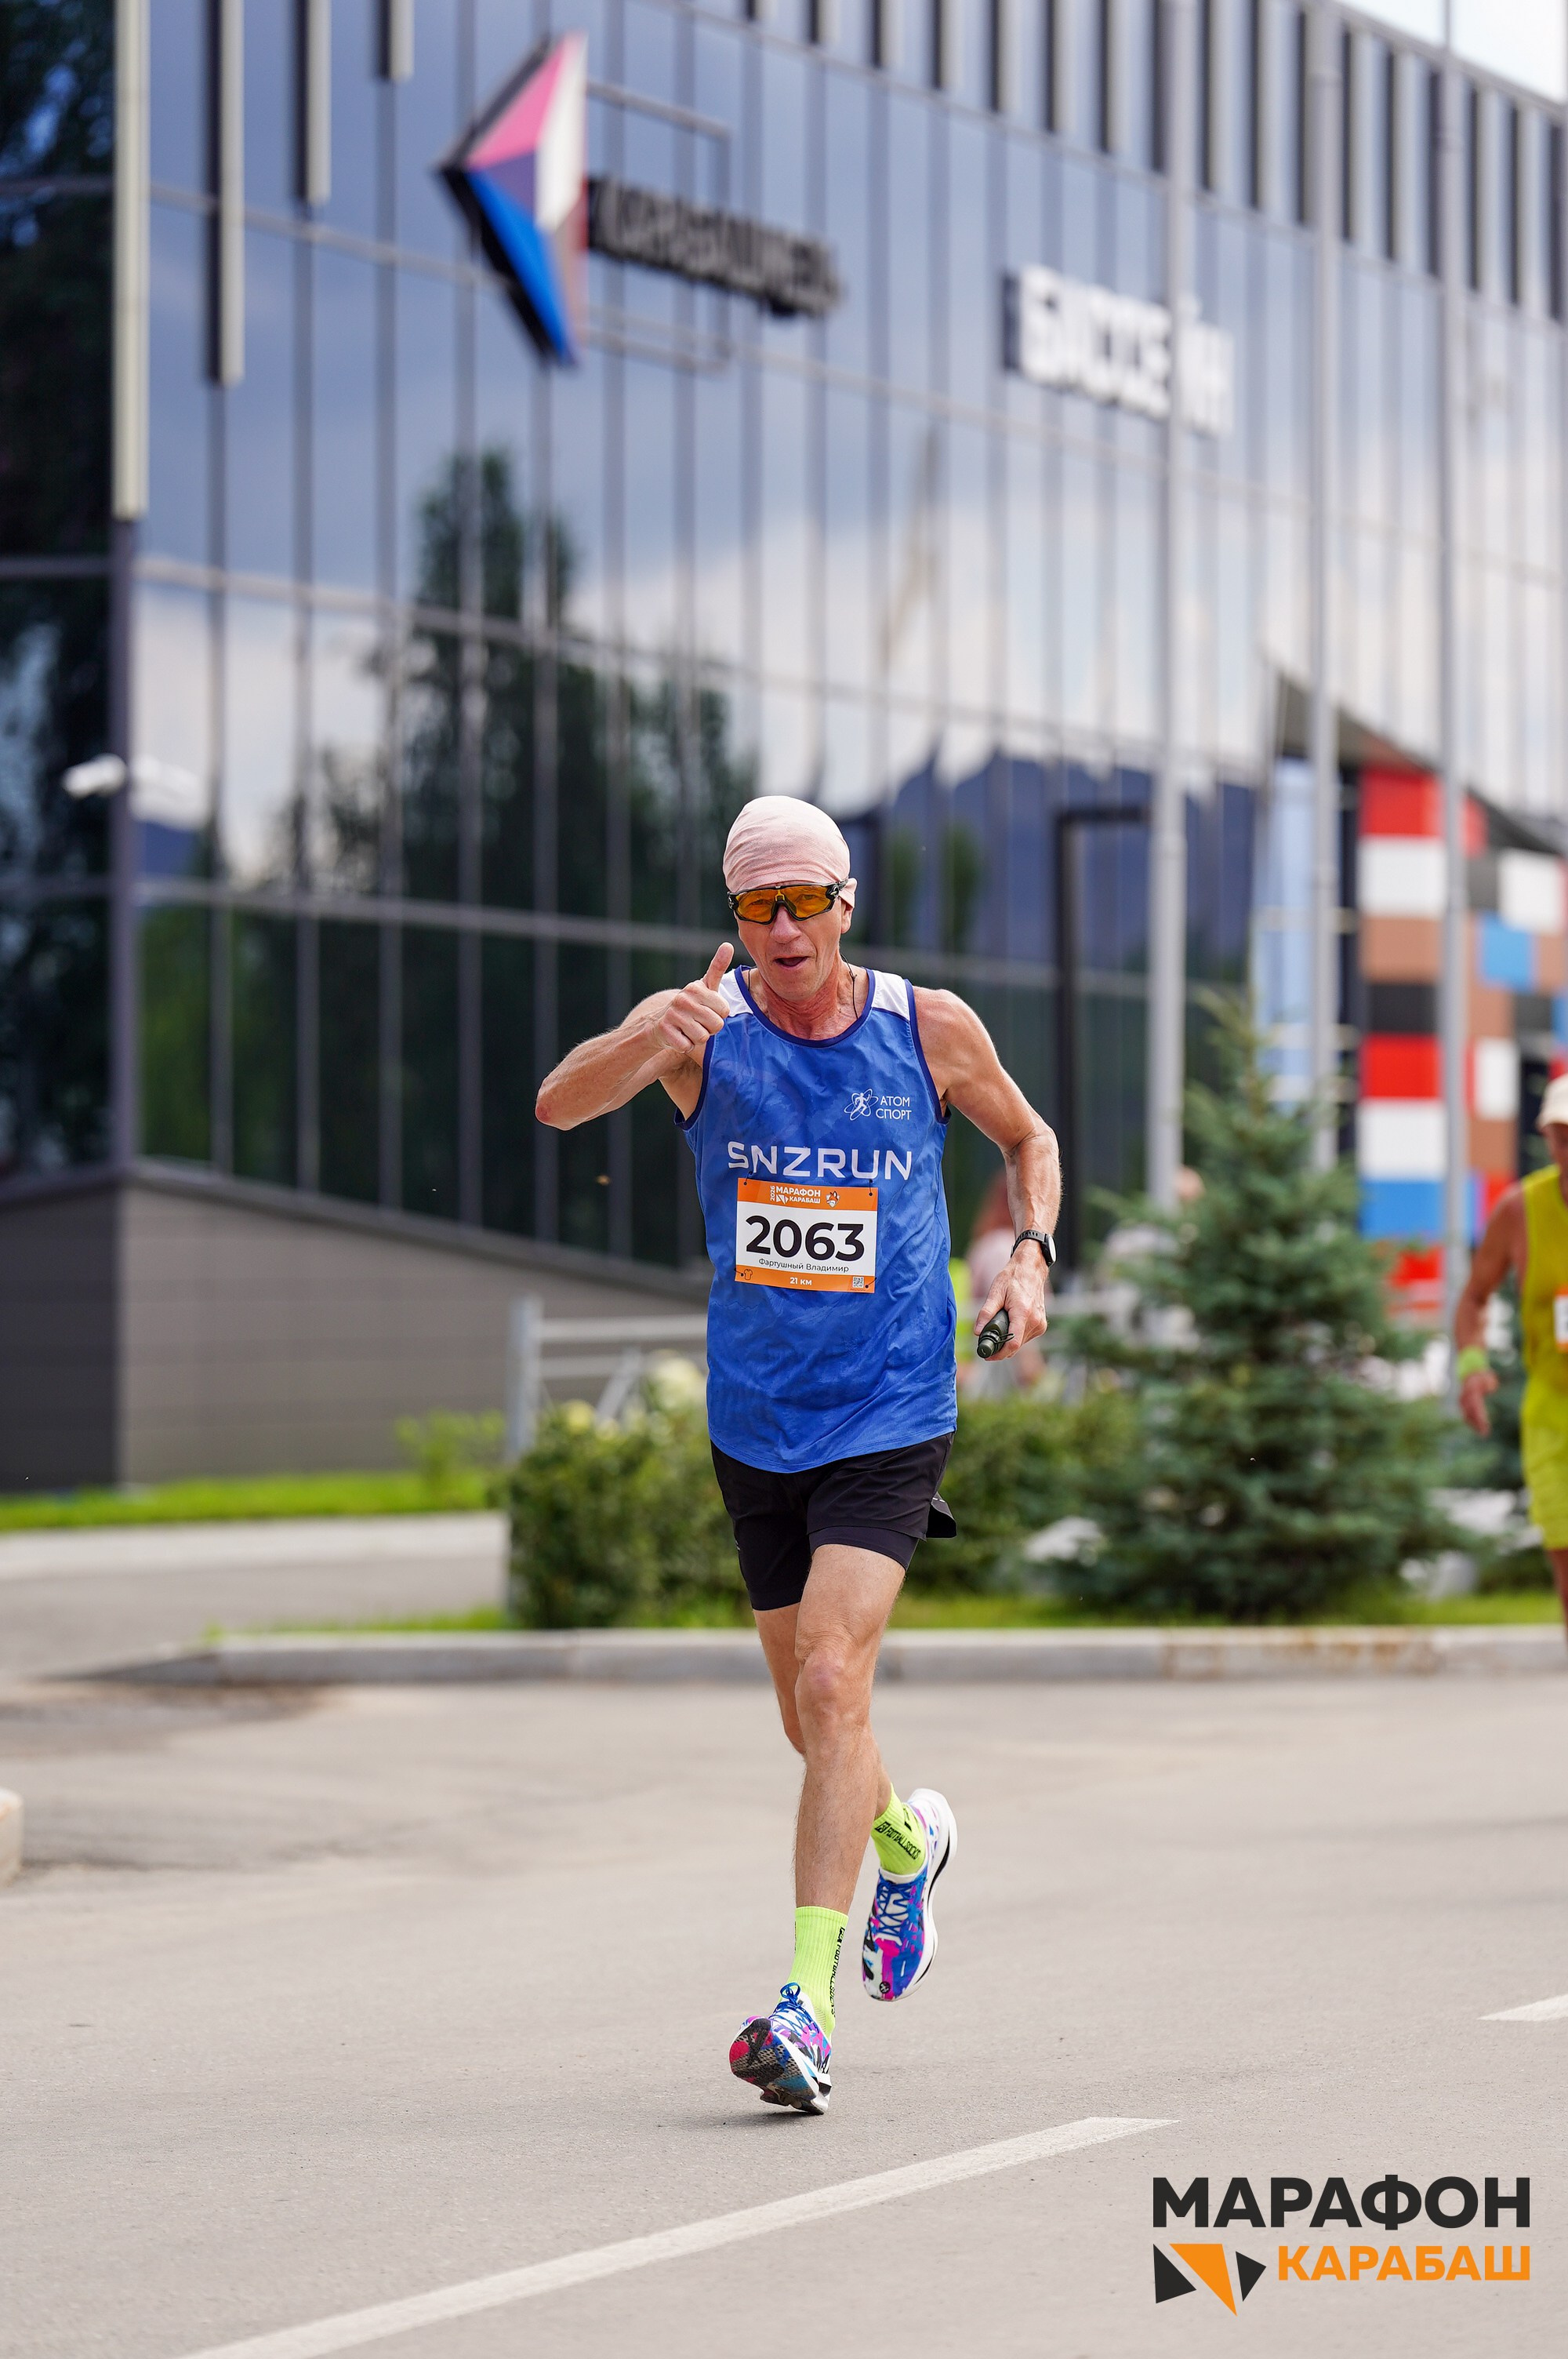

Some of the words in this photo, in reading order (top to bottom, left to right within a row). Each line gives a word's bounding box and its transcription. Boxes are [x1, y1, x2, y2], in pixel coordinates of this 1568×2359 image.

[880, 1096, 910, 1107] АТОМ
[876, 1108, 912, 1120] СПОРТ
[728, 1141, 912, 1180] SNZRUN
[776, 1186, 821, 1197] МАРАФОН
[746, 1216, 865, 1262] 2063
[758, 1258, 804, 1270] Фартушный
[806, 1263, 849, 1272] Владимир
